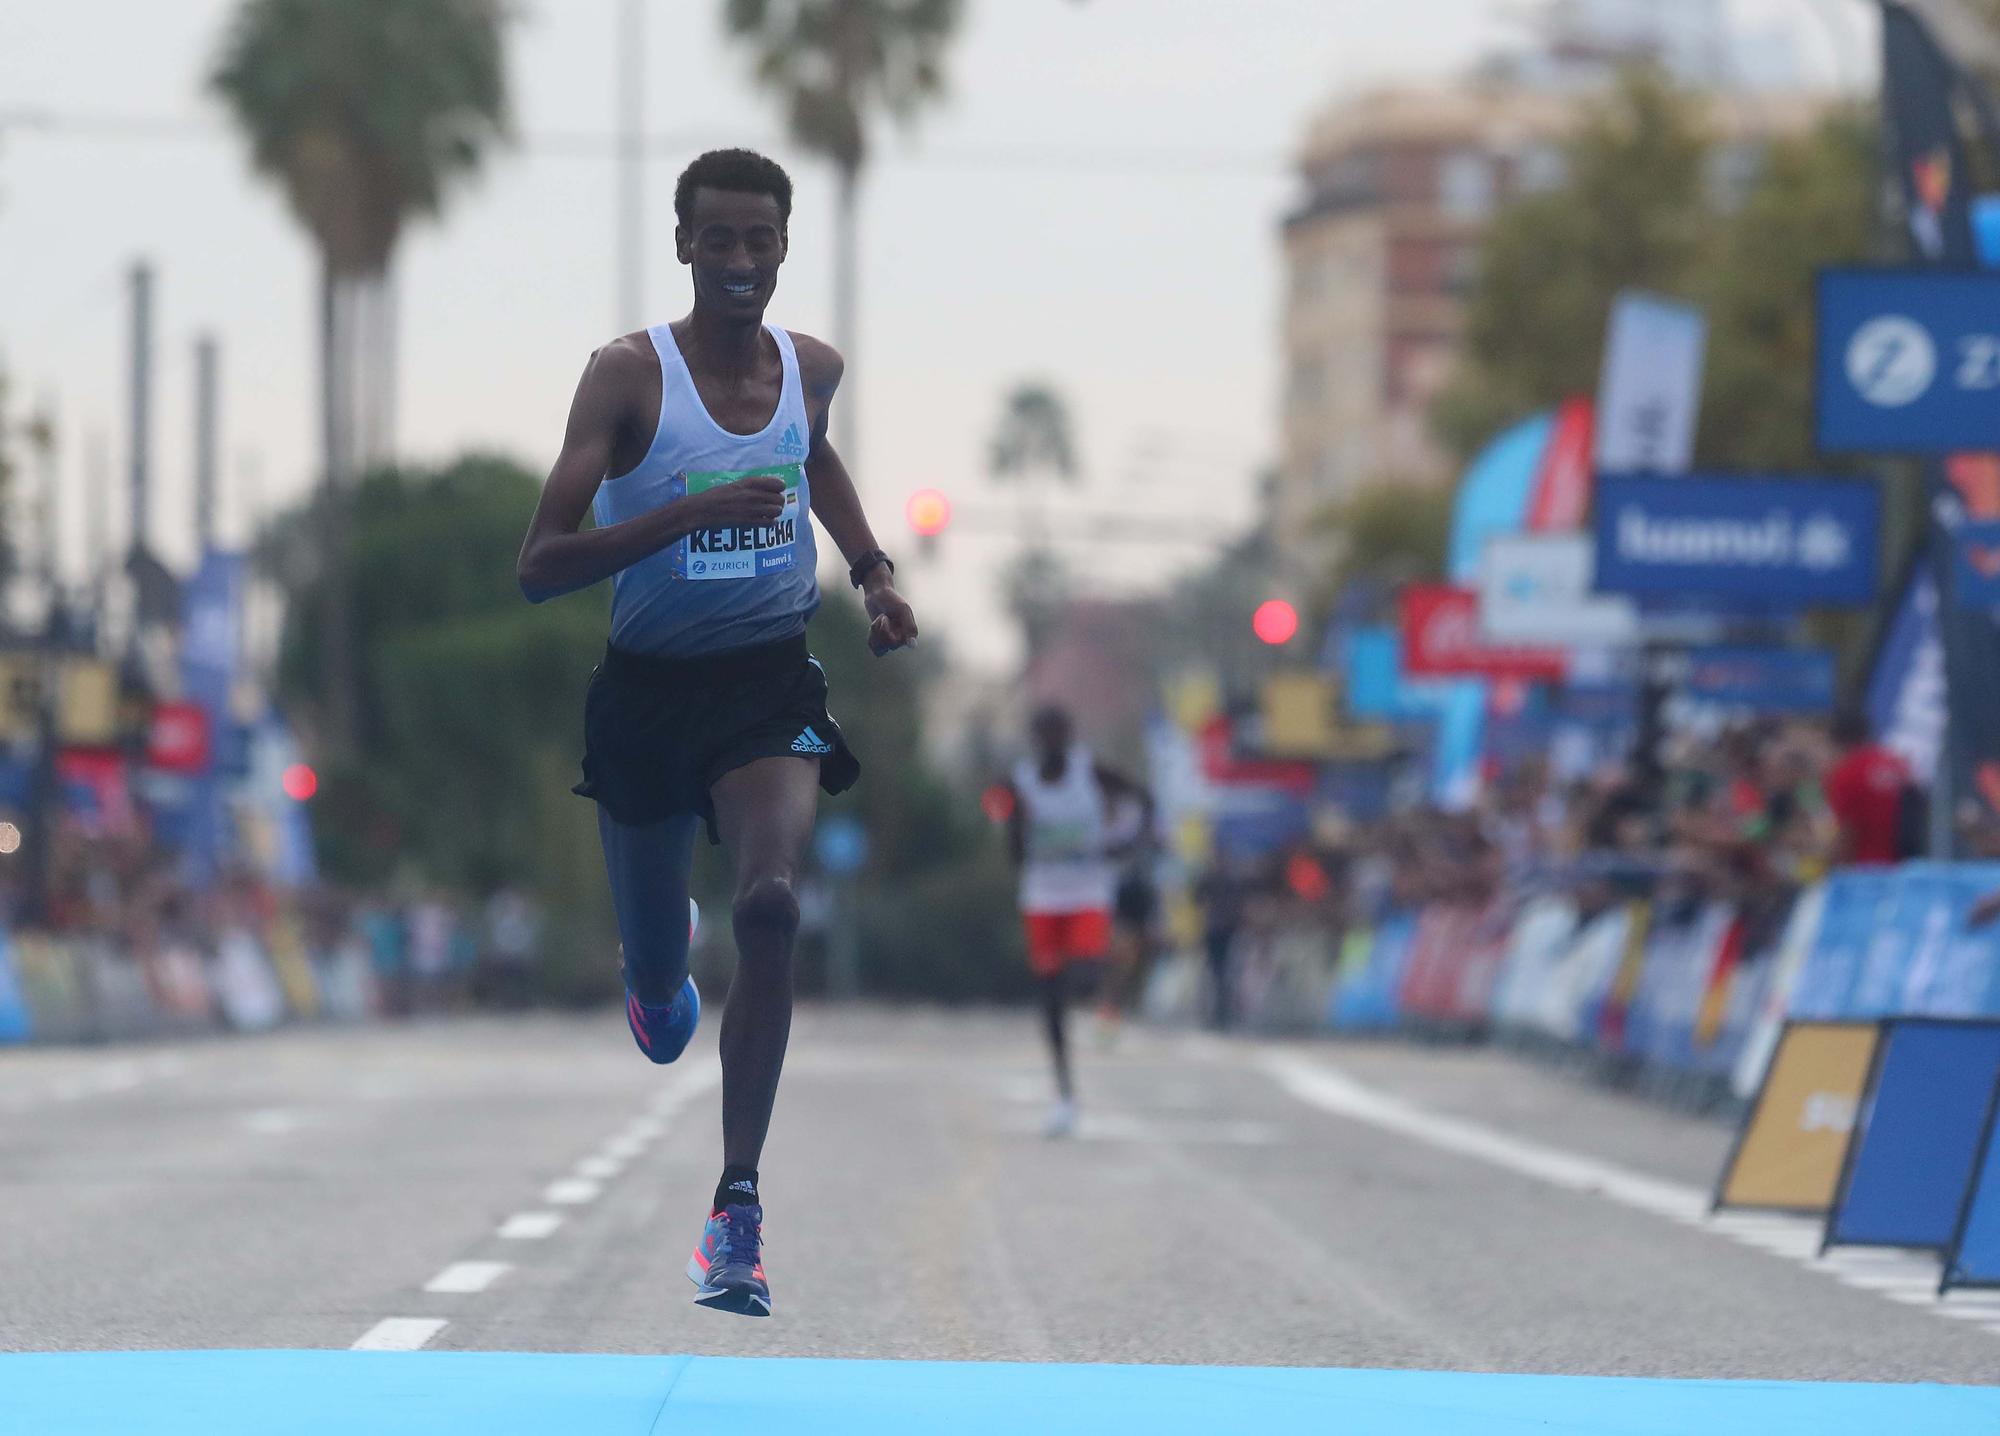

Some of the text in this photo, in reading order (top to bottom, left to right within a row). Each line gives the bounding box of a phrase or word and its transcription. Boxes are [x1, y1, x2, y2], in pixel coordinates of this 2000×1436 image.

[690, 518, 795, 553] KEJELCHA
[711, 561, 749, 571] ZURICH
[762, 553, 787, 568] luanvi
[790, 743, 831, 753] adidas
[728, 1184, 756, 1196] adidas
